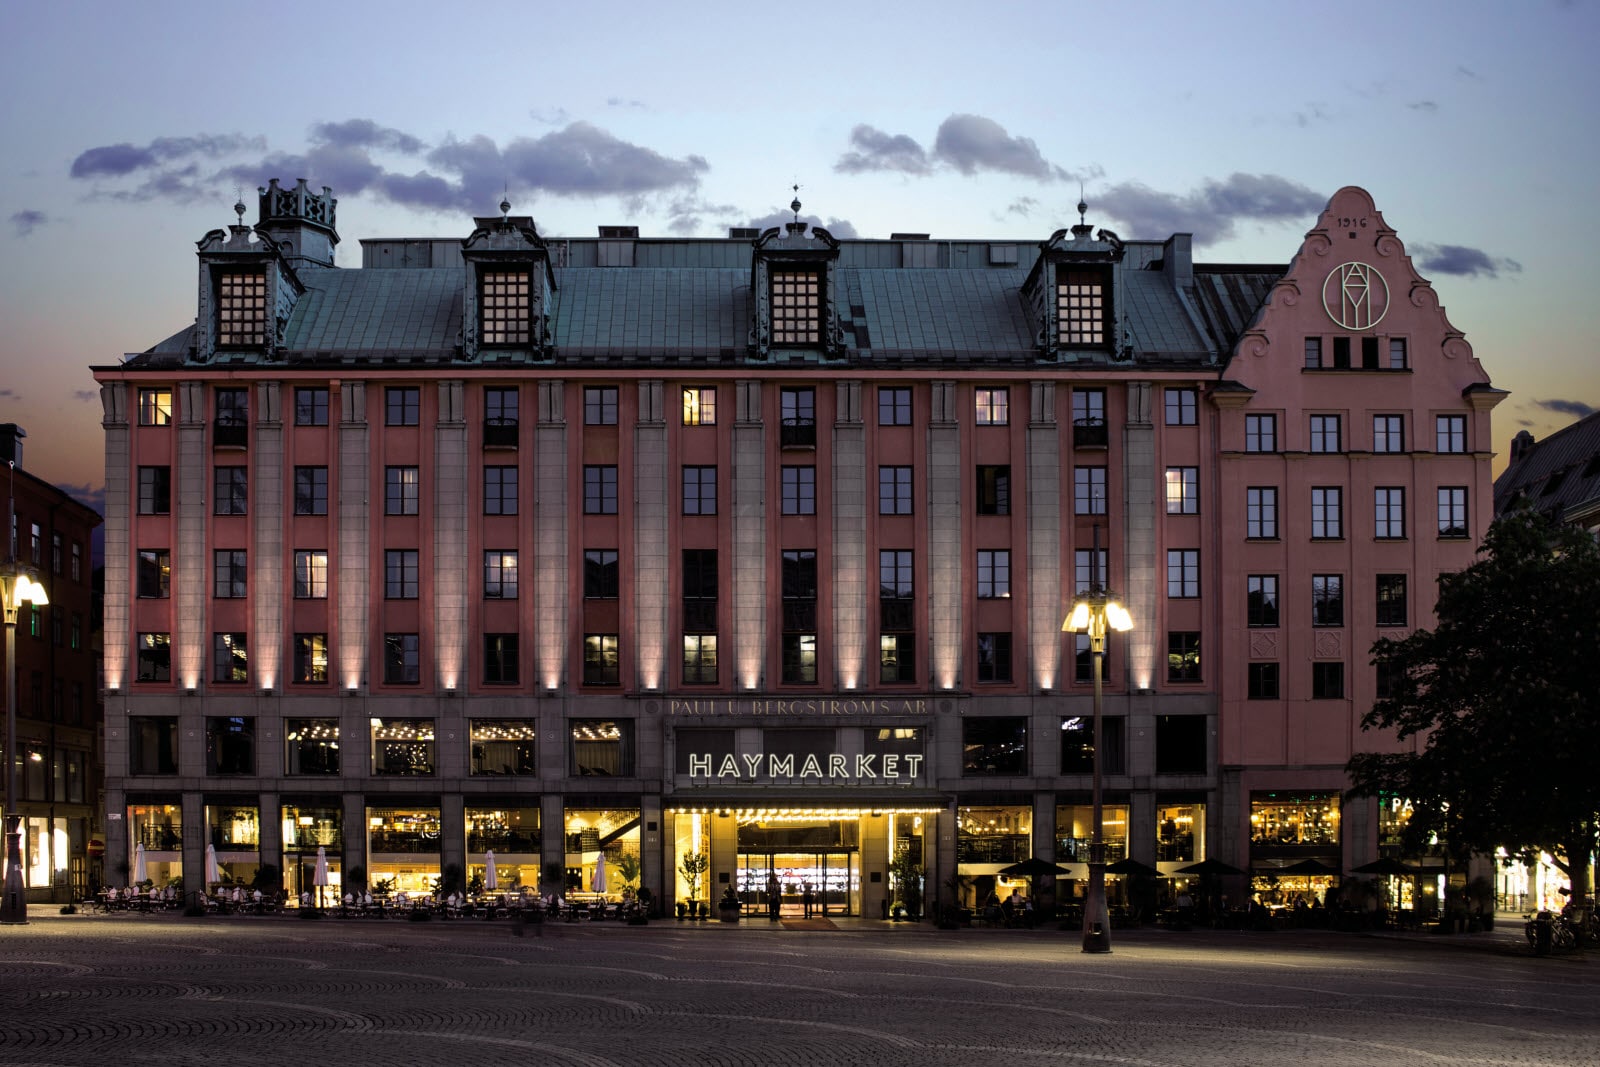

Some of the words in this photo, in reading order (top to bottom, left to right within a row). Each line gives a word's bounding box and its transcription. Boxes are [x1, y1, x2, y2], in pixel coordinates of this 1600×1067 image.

[1337, 218, 1367, 228] 1916
[671, 700, 717, 715] PAUL
[689, 753, 923, 778] HAYMARKET
